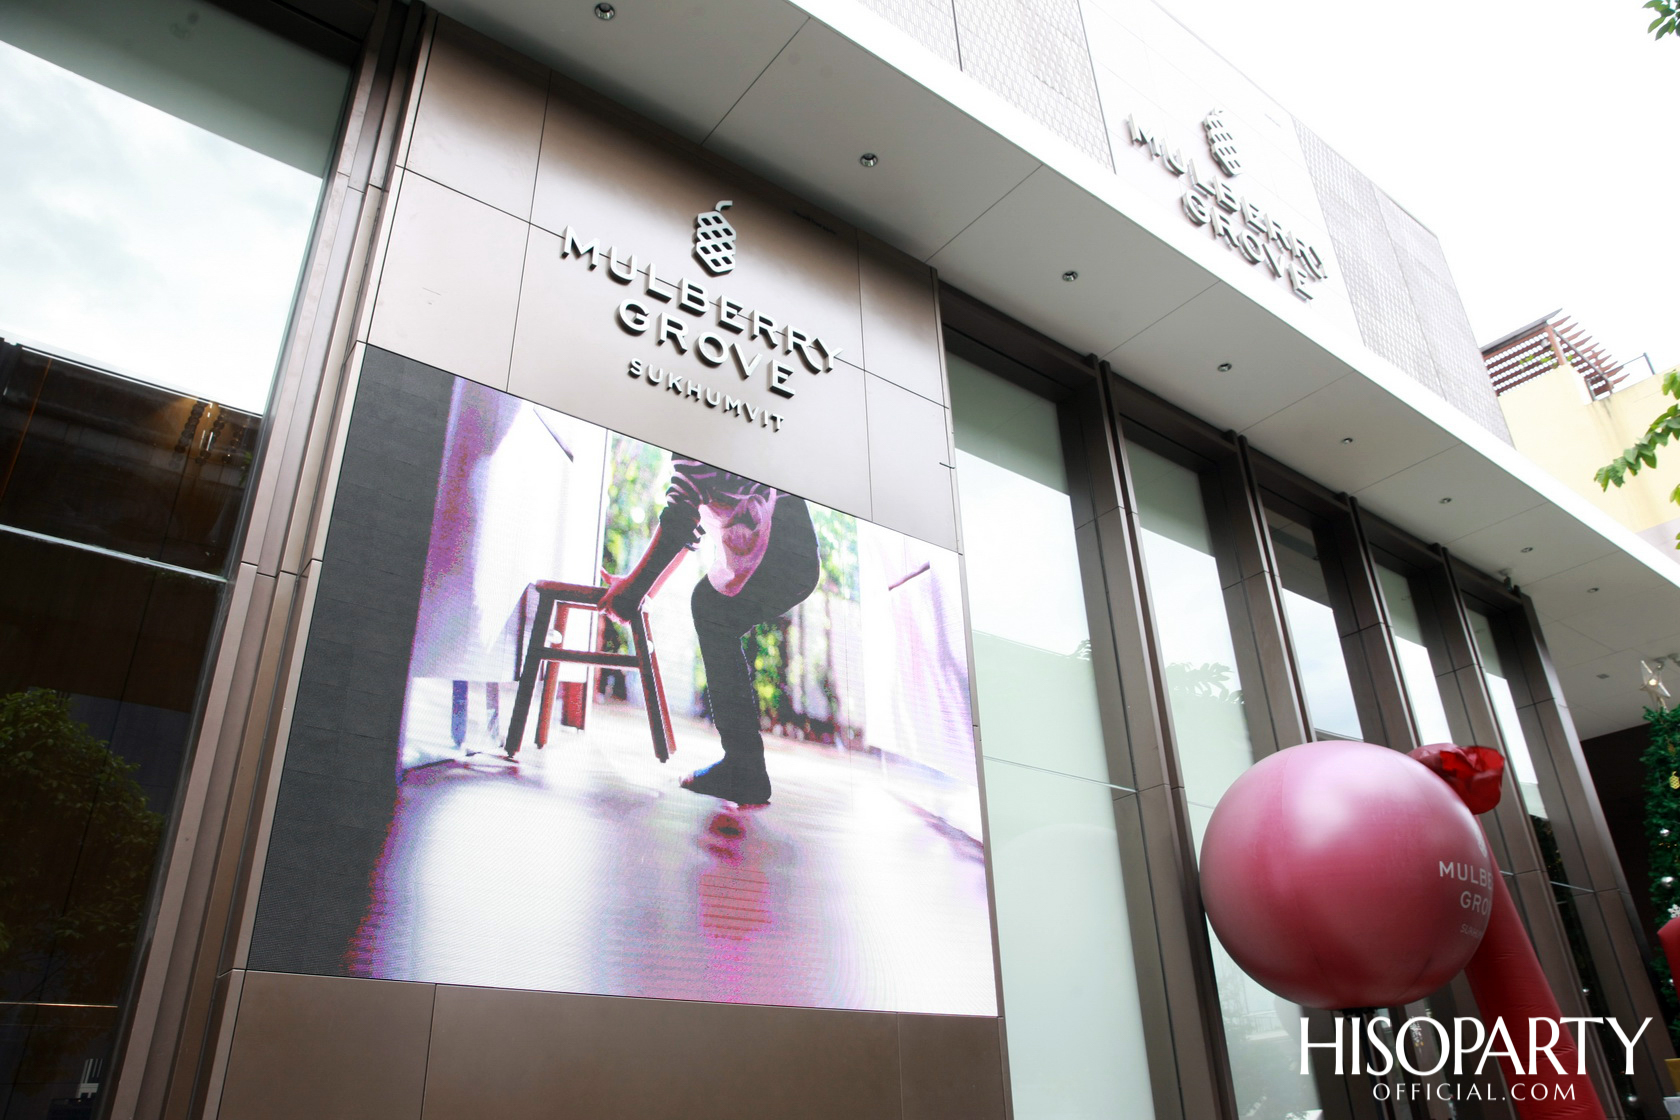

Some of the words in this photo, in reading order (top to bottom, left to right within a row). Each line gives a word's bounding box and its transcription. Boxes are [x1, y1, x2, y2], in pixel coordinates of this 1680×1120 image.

[1125, 112, 1328, 281] MULBERRY
[1181, 189, 1314, 303] GROVE
[561, 225, 843, 374] MULBERRY
[616, 298, 795, 398] GROVE
[628, 357, 784, 432] SUKHUMVIT
[1439, 860, 1493, 890] MULBE
[1460, 890, 1489, 916] GRO
